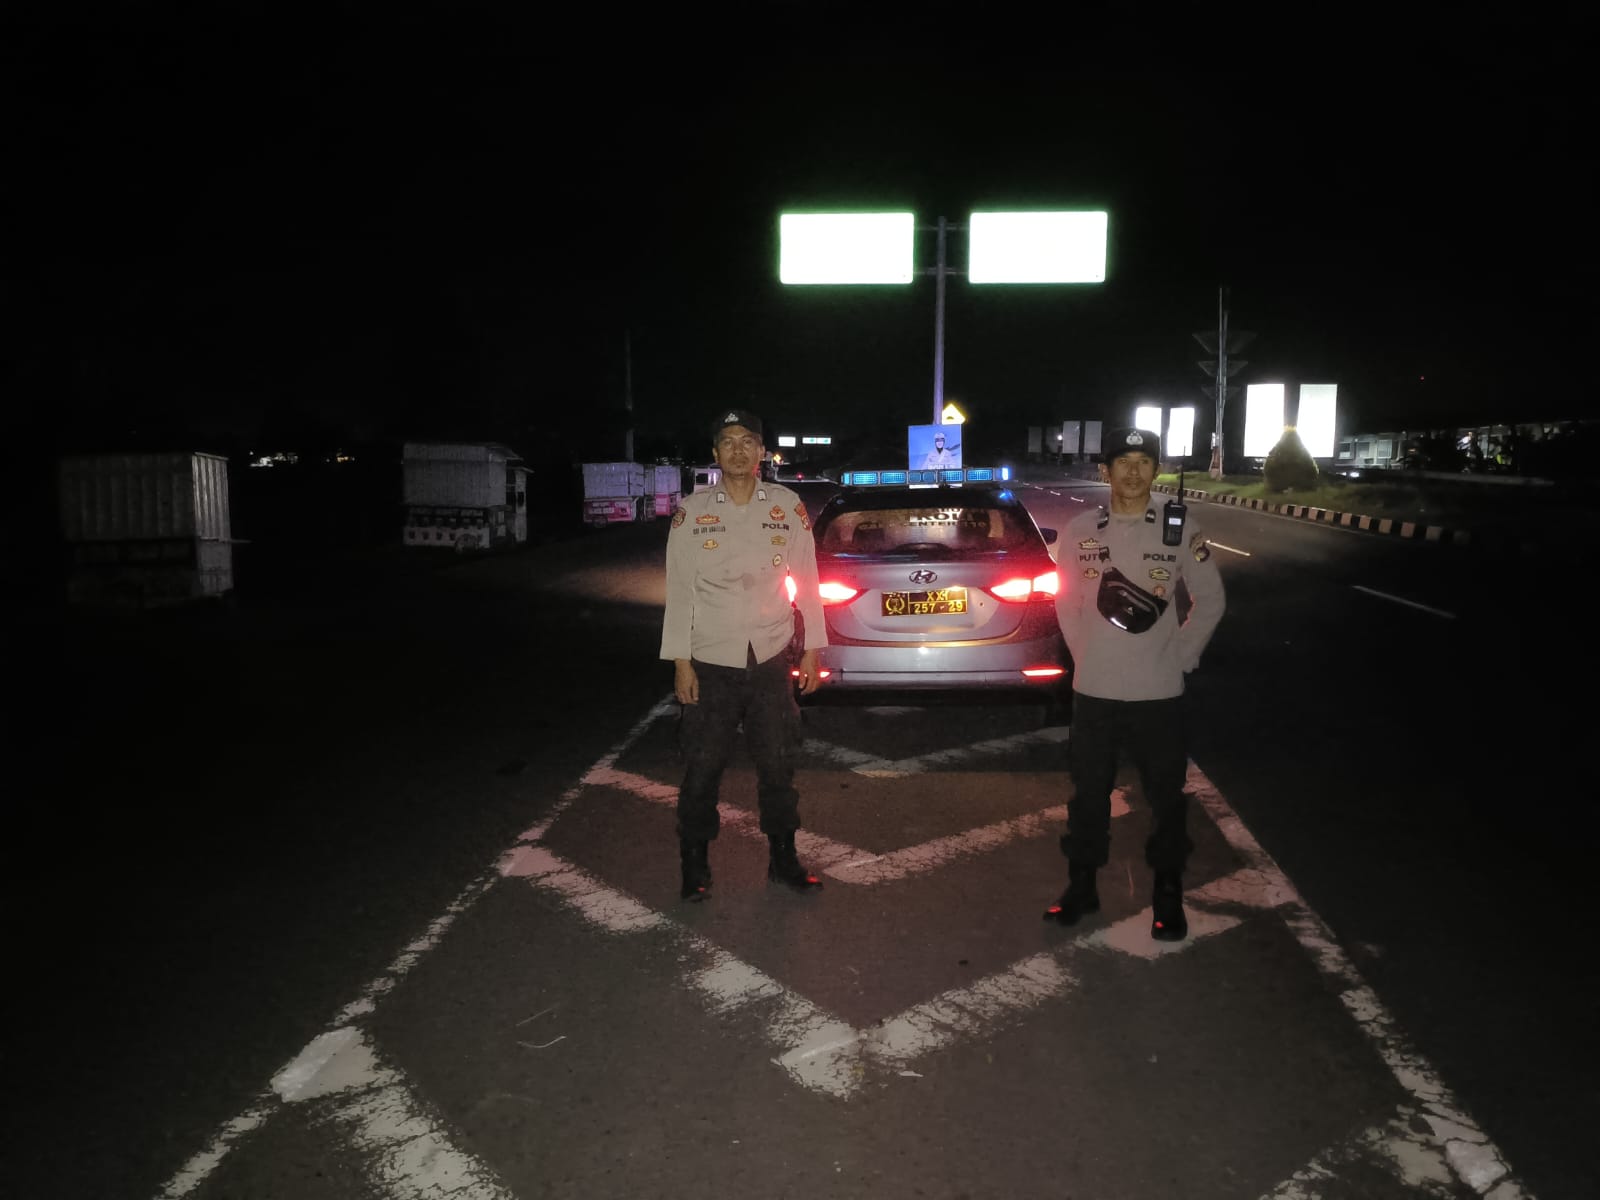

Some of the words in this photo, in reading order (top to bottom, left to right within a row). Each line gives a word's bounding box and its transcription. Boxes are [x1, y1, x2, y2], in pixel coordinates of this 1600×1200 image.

[1143, 553, 1176, 562] POLRI
[914, 603, 936, 613] 257
[947, 601, 963, 612] 29
